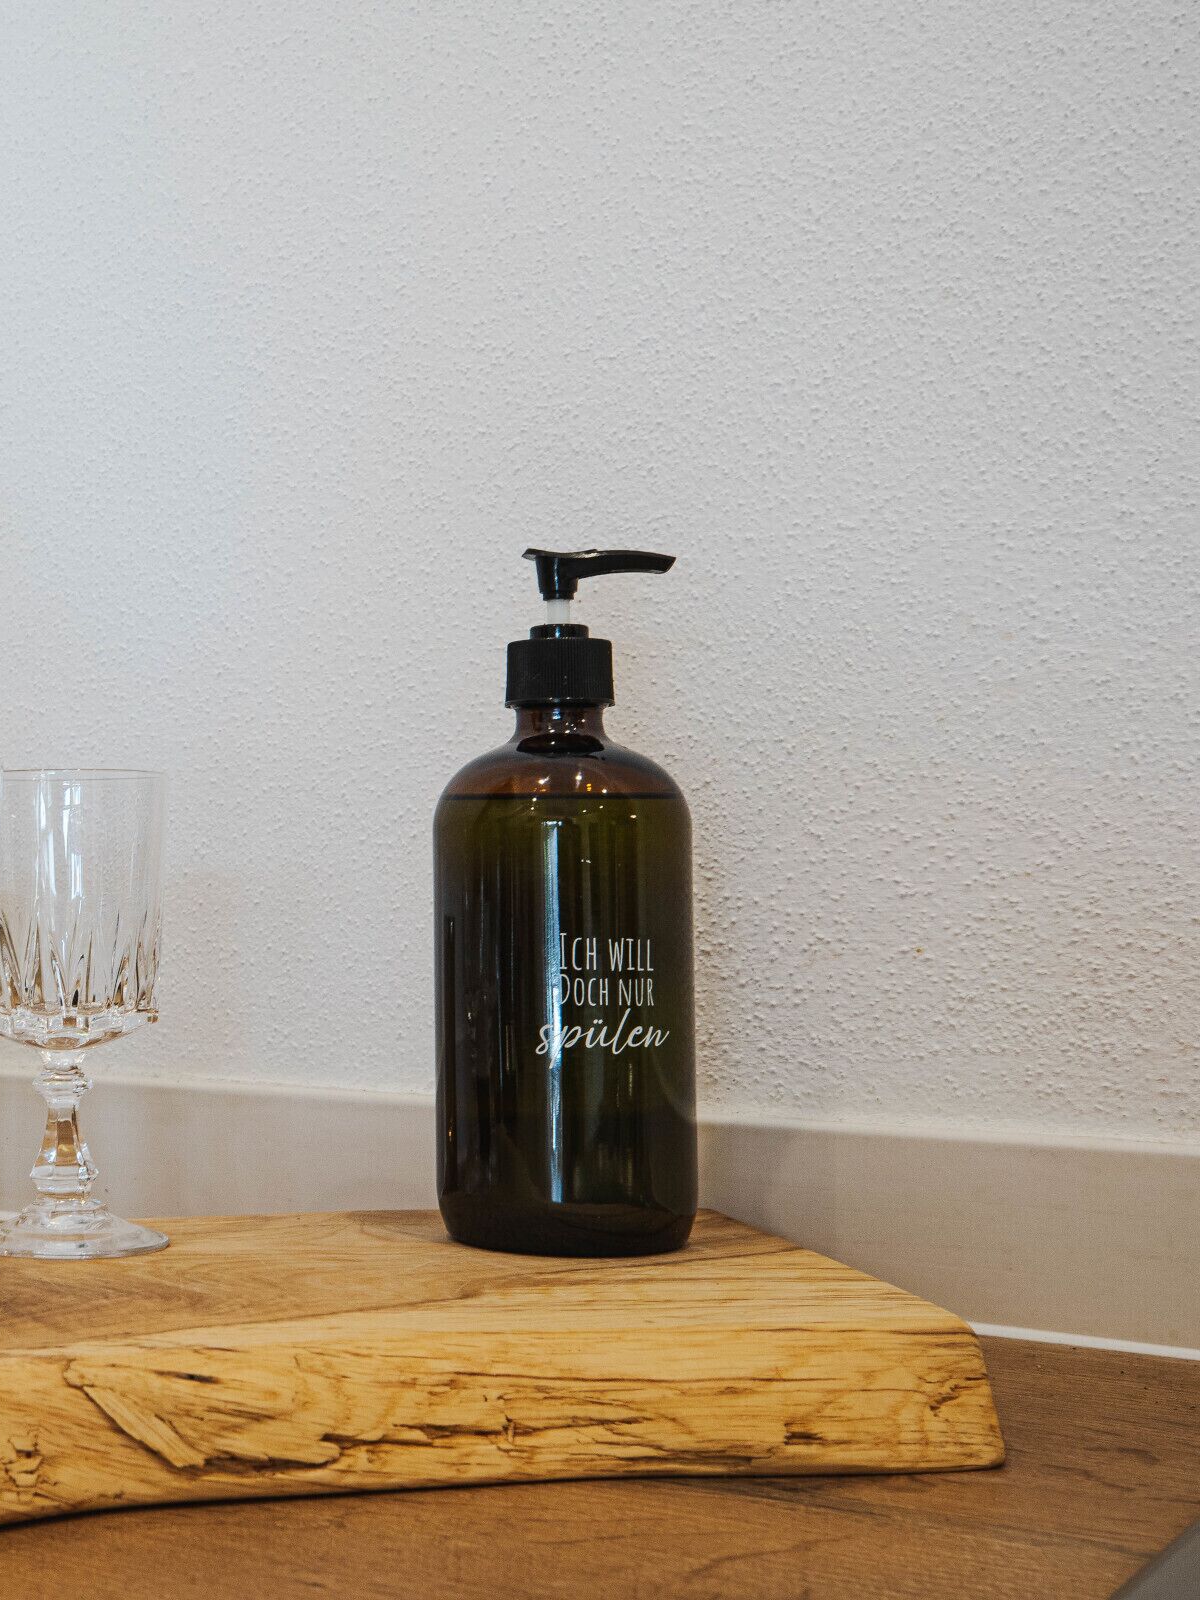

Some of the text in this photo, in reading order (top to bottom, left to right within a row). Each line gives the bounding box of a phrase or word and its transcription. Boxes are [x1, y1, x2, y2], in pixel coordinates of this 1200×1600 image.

[559, 932, 655, 972] ICH WILL
[557, 973, 655, 1007] DOCH NUR
[535, 1007, 670, 1069] spülen
